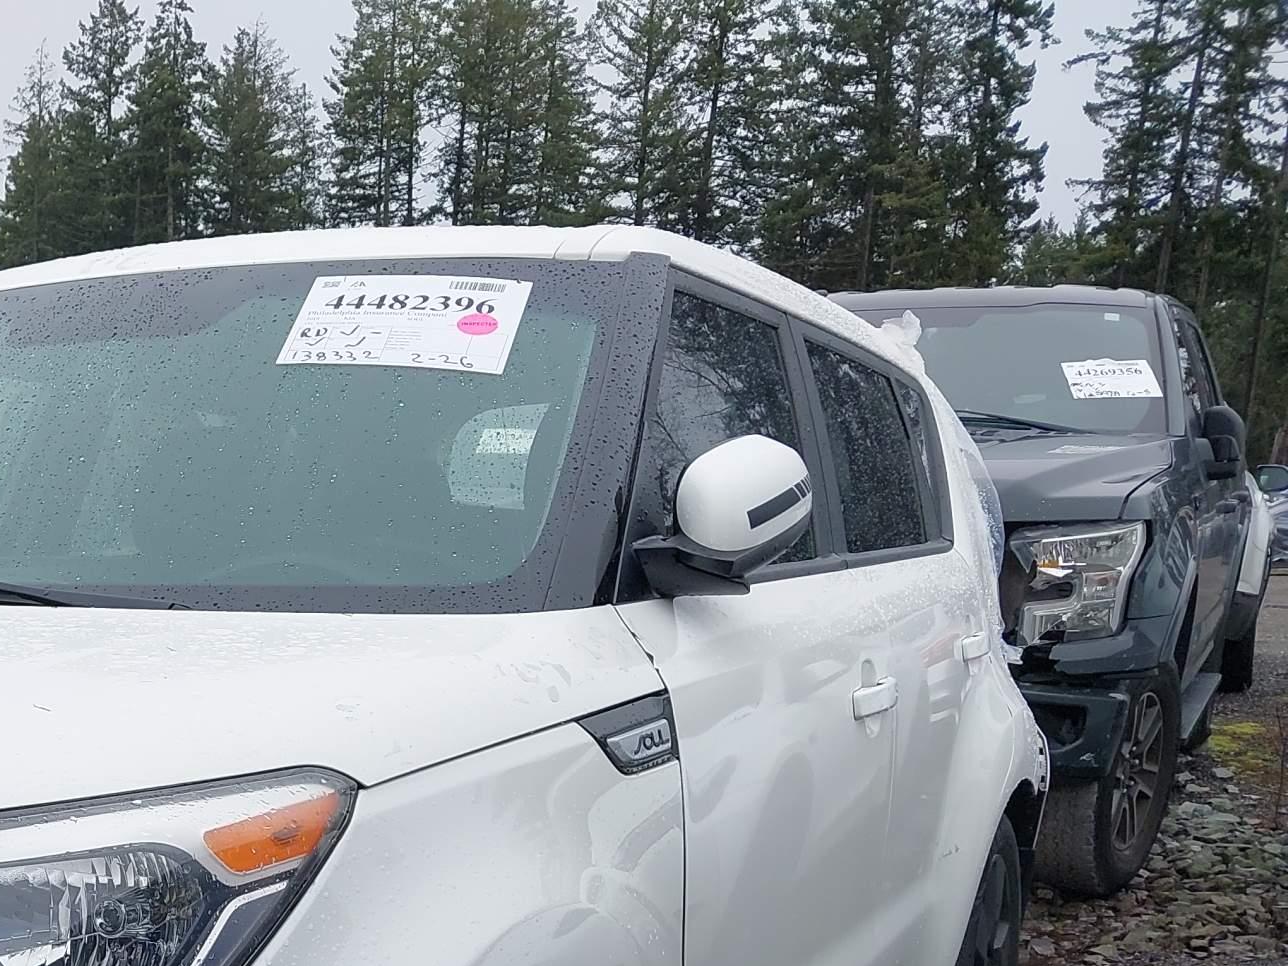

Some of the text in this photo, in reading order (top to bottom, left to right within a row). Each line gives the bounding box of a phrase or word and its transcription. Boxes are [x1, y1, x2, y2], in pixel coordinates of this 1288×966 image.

[324, 294, 497, 315] 44482396
[291, 350, 474, 368] 138332 2-26
[1075, 367, 1143, 377] 44269356
